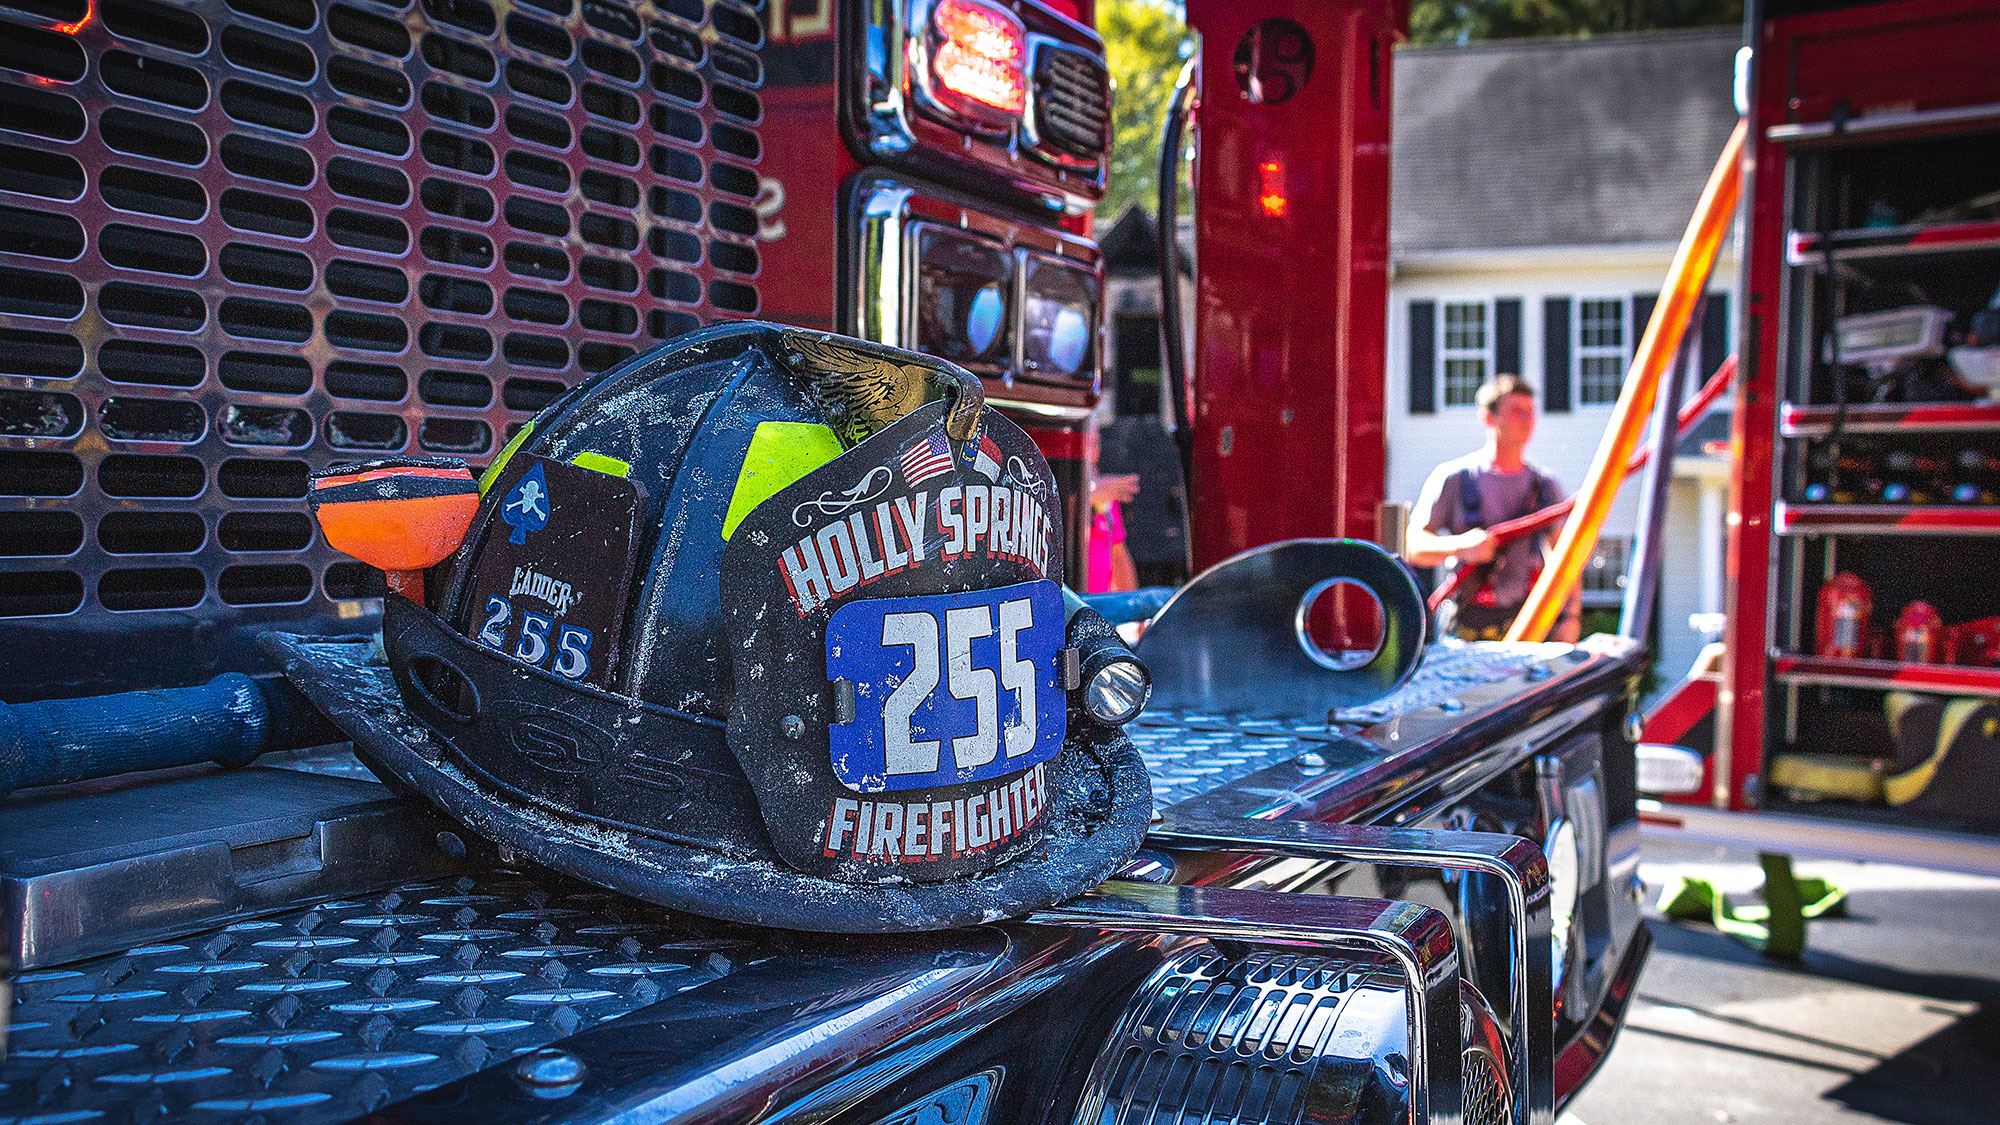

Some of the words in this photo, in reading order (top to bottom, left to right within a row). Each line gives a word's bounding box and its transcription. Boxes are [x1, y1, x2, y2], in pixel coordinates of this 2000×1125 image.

[509, 566, 575, 616] LADDER
[777, 491, 929, 619] HOLLY
[937, 485, 1052, 579] SPRINGS
[478, 592, 593, 681] 255
[880, 598, 1038, 776] 255
[823, 764, 1048, 862] FIREFIGHTER
